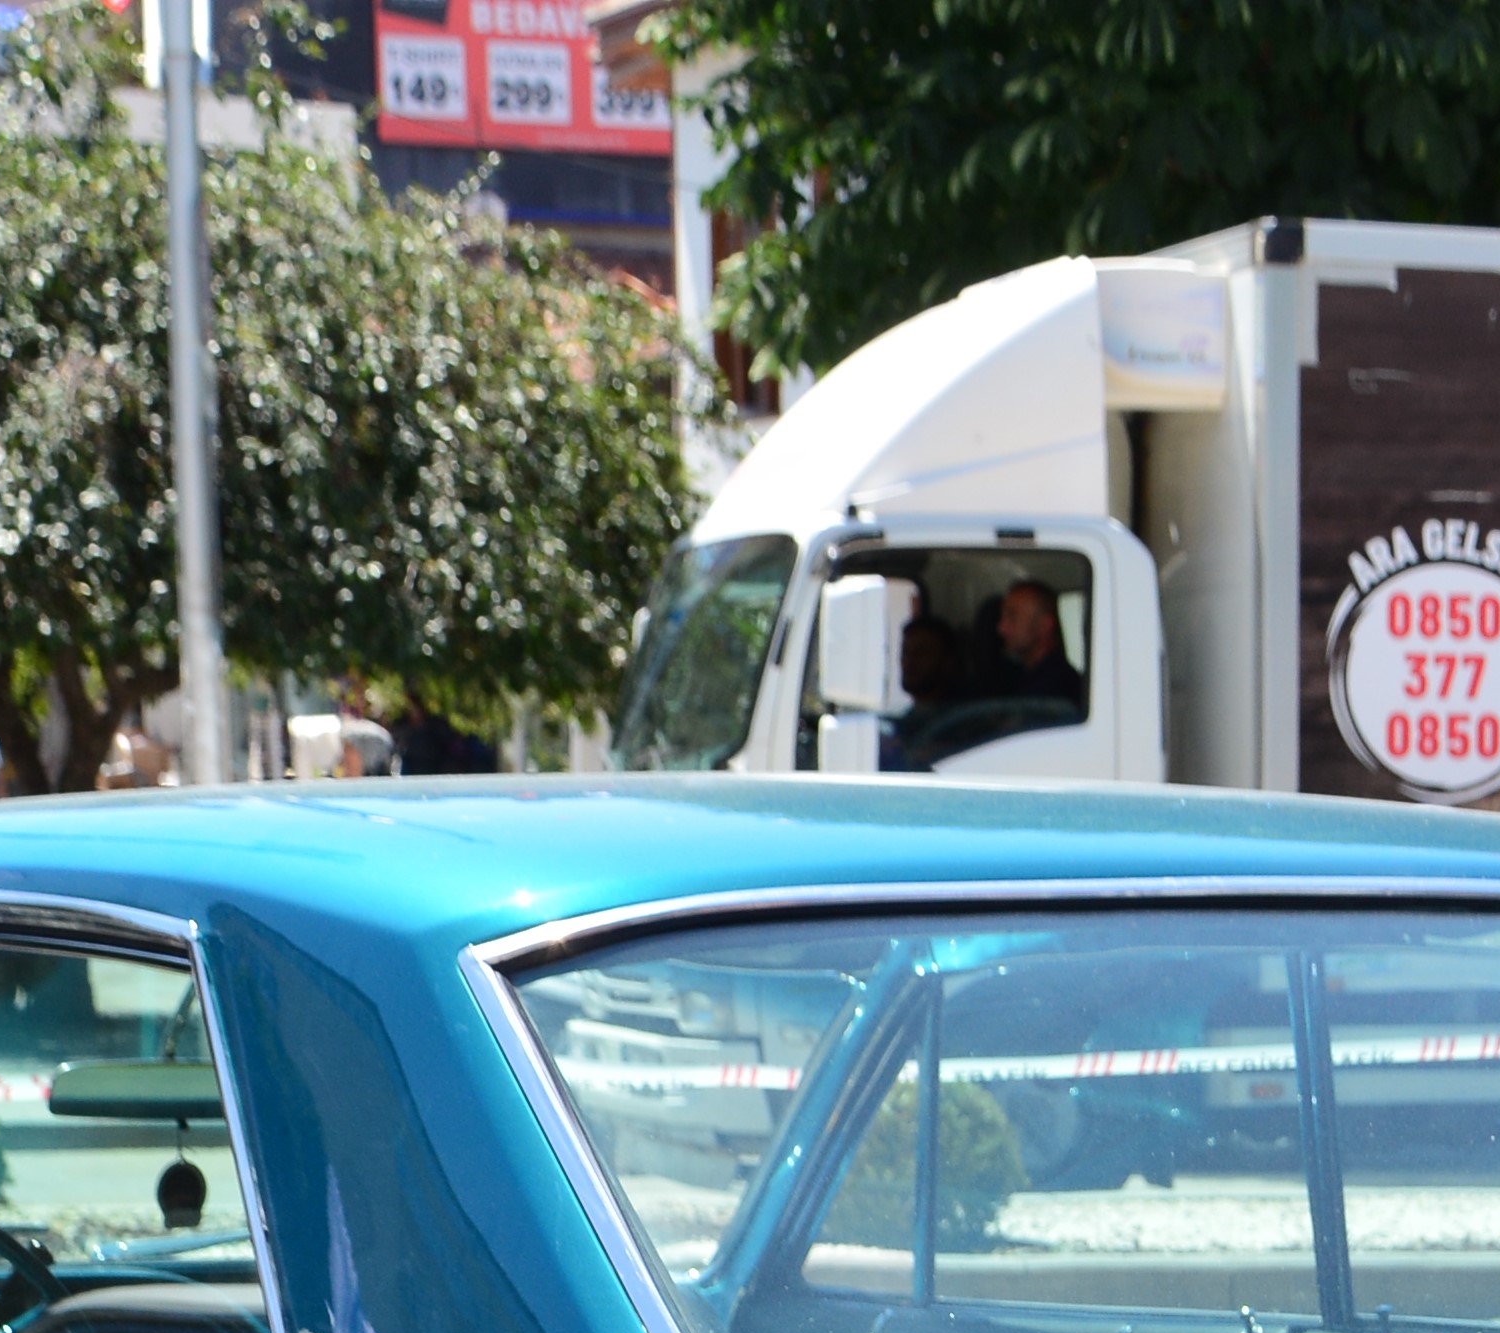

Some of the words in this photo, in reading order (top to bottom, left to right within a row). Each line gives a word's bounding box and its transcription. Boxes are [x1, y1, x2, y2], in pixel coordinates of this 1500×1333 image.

[1347, 524, 1420, 594] ARA
[1404, 653, 1486, 699] 377
[1386, 713, 1500, 758] 0850
